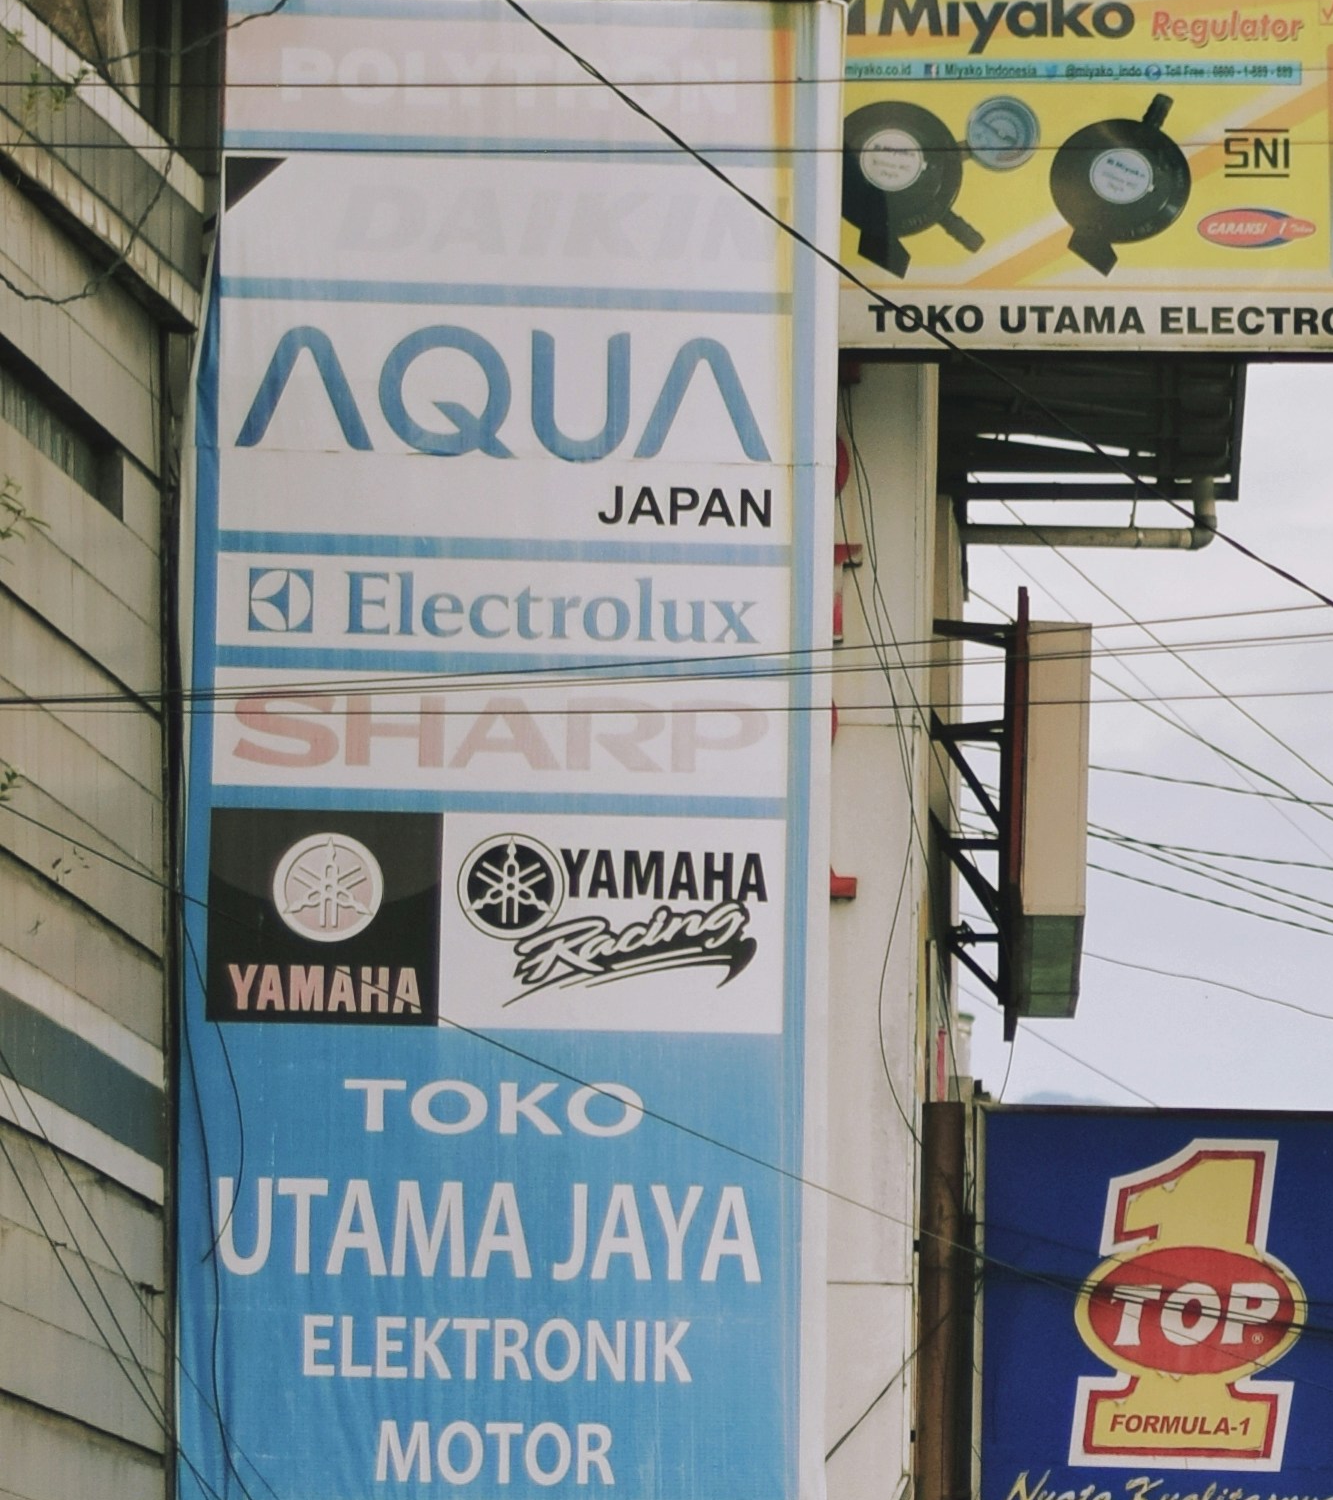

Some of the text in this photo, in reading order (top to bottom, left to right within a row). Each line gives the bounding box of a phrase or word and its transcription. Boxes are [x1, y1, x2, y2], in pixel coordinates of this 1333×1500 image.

[1151, 10, 1304, 48] Regulator
[1225, 138, 1290, 170] SNI
[868, 304, 985, 334] TOKO
[999, 306, 1145, 335] UTAMA
[234, 323, 772, 463] AQUA
[598, 486, 774, 528] JAPAN
[344, 569, 760, 644] Electrolux
[232, 693, 769, 773] SHARP
[562, 849, 768, 904] YAMAHA
[520, 902, 752, 980] Racing
[228, 962, 423, 1015] YAMAHA
[344, 1078, 646, 1138] TOKO
[218, 1176, 762, 1284] UTAMA JAYA
[1110, 1281, 1281, 1348] TOP
[302, 1313, 693, 1384] ELEKTRONIK
[375, 1419, 615, 1486] MOTOR
[1109, 1413, 1252, 1437] FORMULA-1
